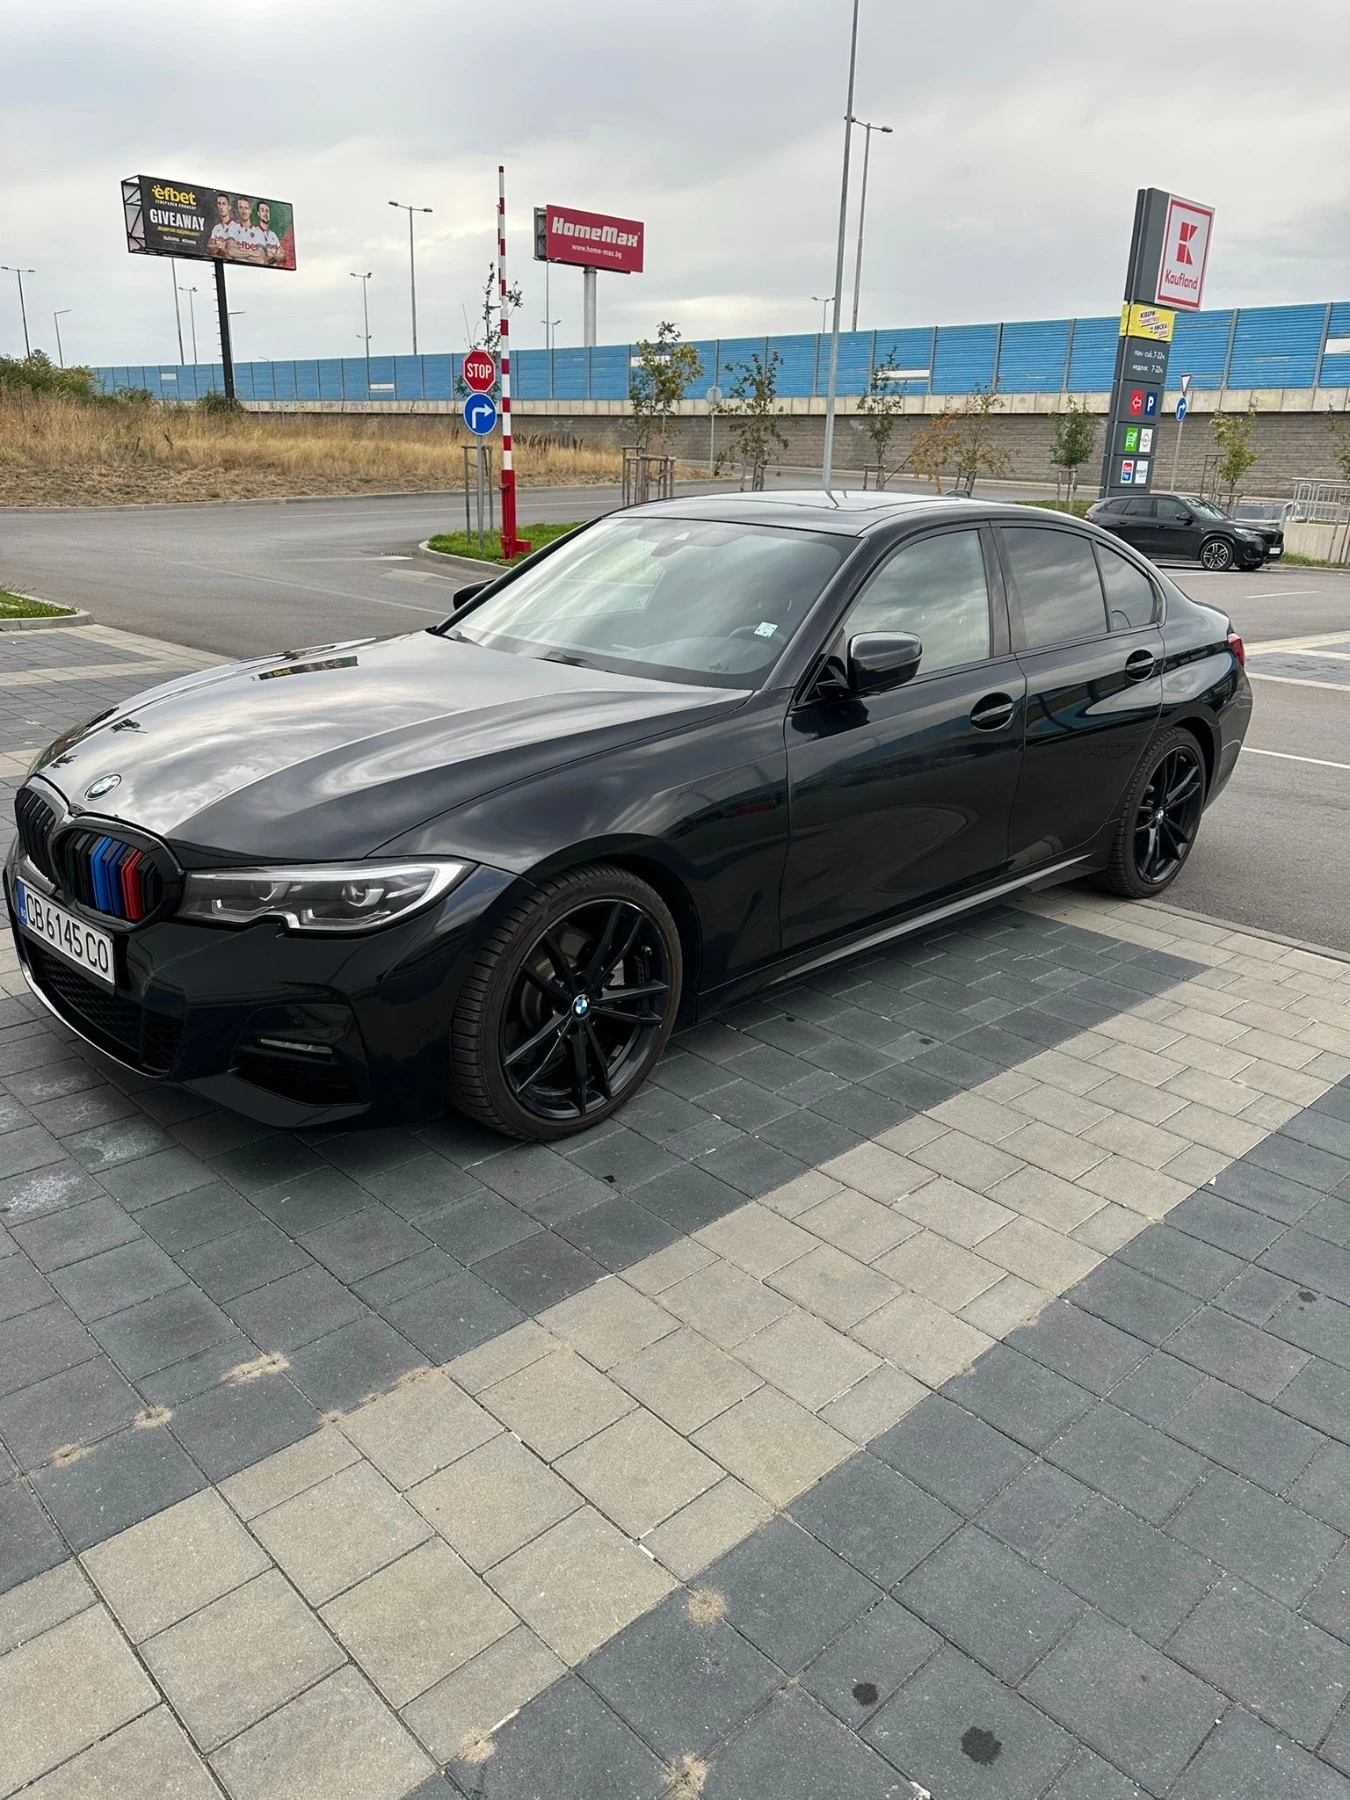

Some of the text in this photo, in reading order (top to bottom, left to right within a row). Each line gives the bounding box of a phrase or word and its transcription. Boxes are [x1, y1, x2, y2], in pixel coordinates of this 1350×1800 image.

[150, 208, 205, 231] GIVEAWAY
[552, 216, 639, 247] HomeMax
[571, 244, 622, 259] www.home-max.bg
[1165, 269, 1198, 289] Kaufland
[467, 363, 492, 379] STOP
[1147, 396, 1154, 411] P
